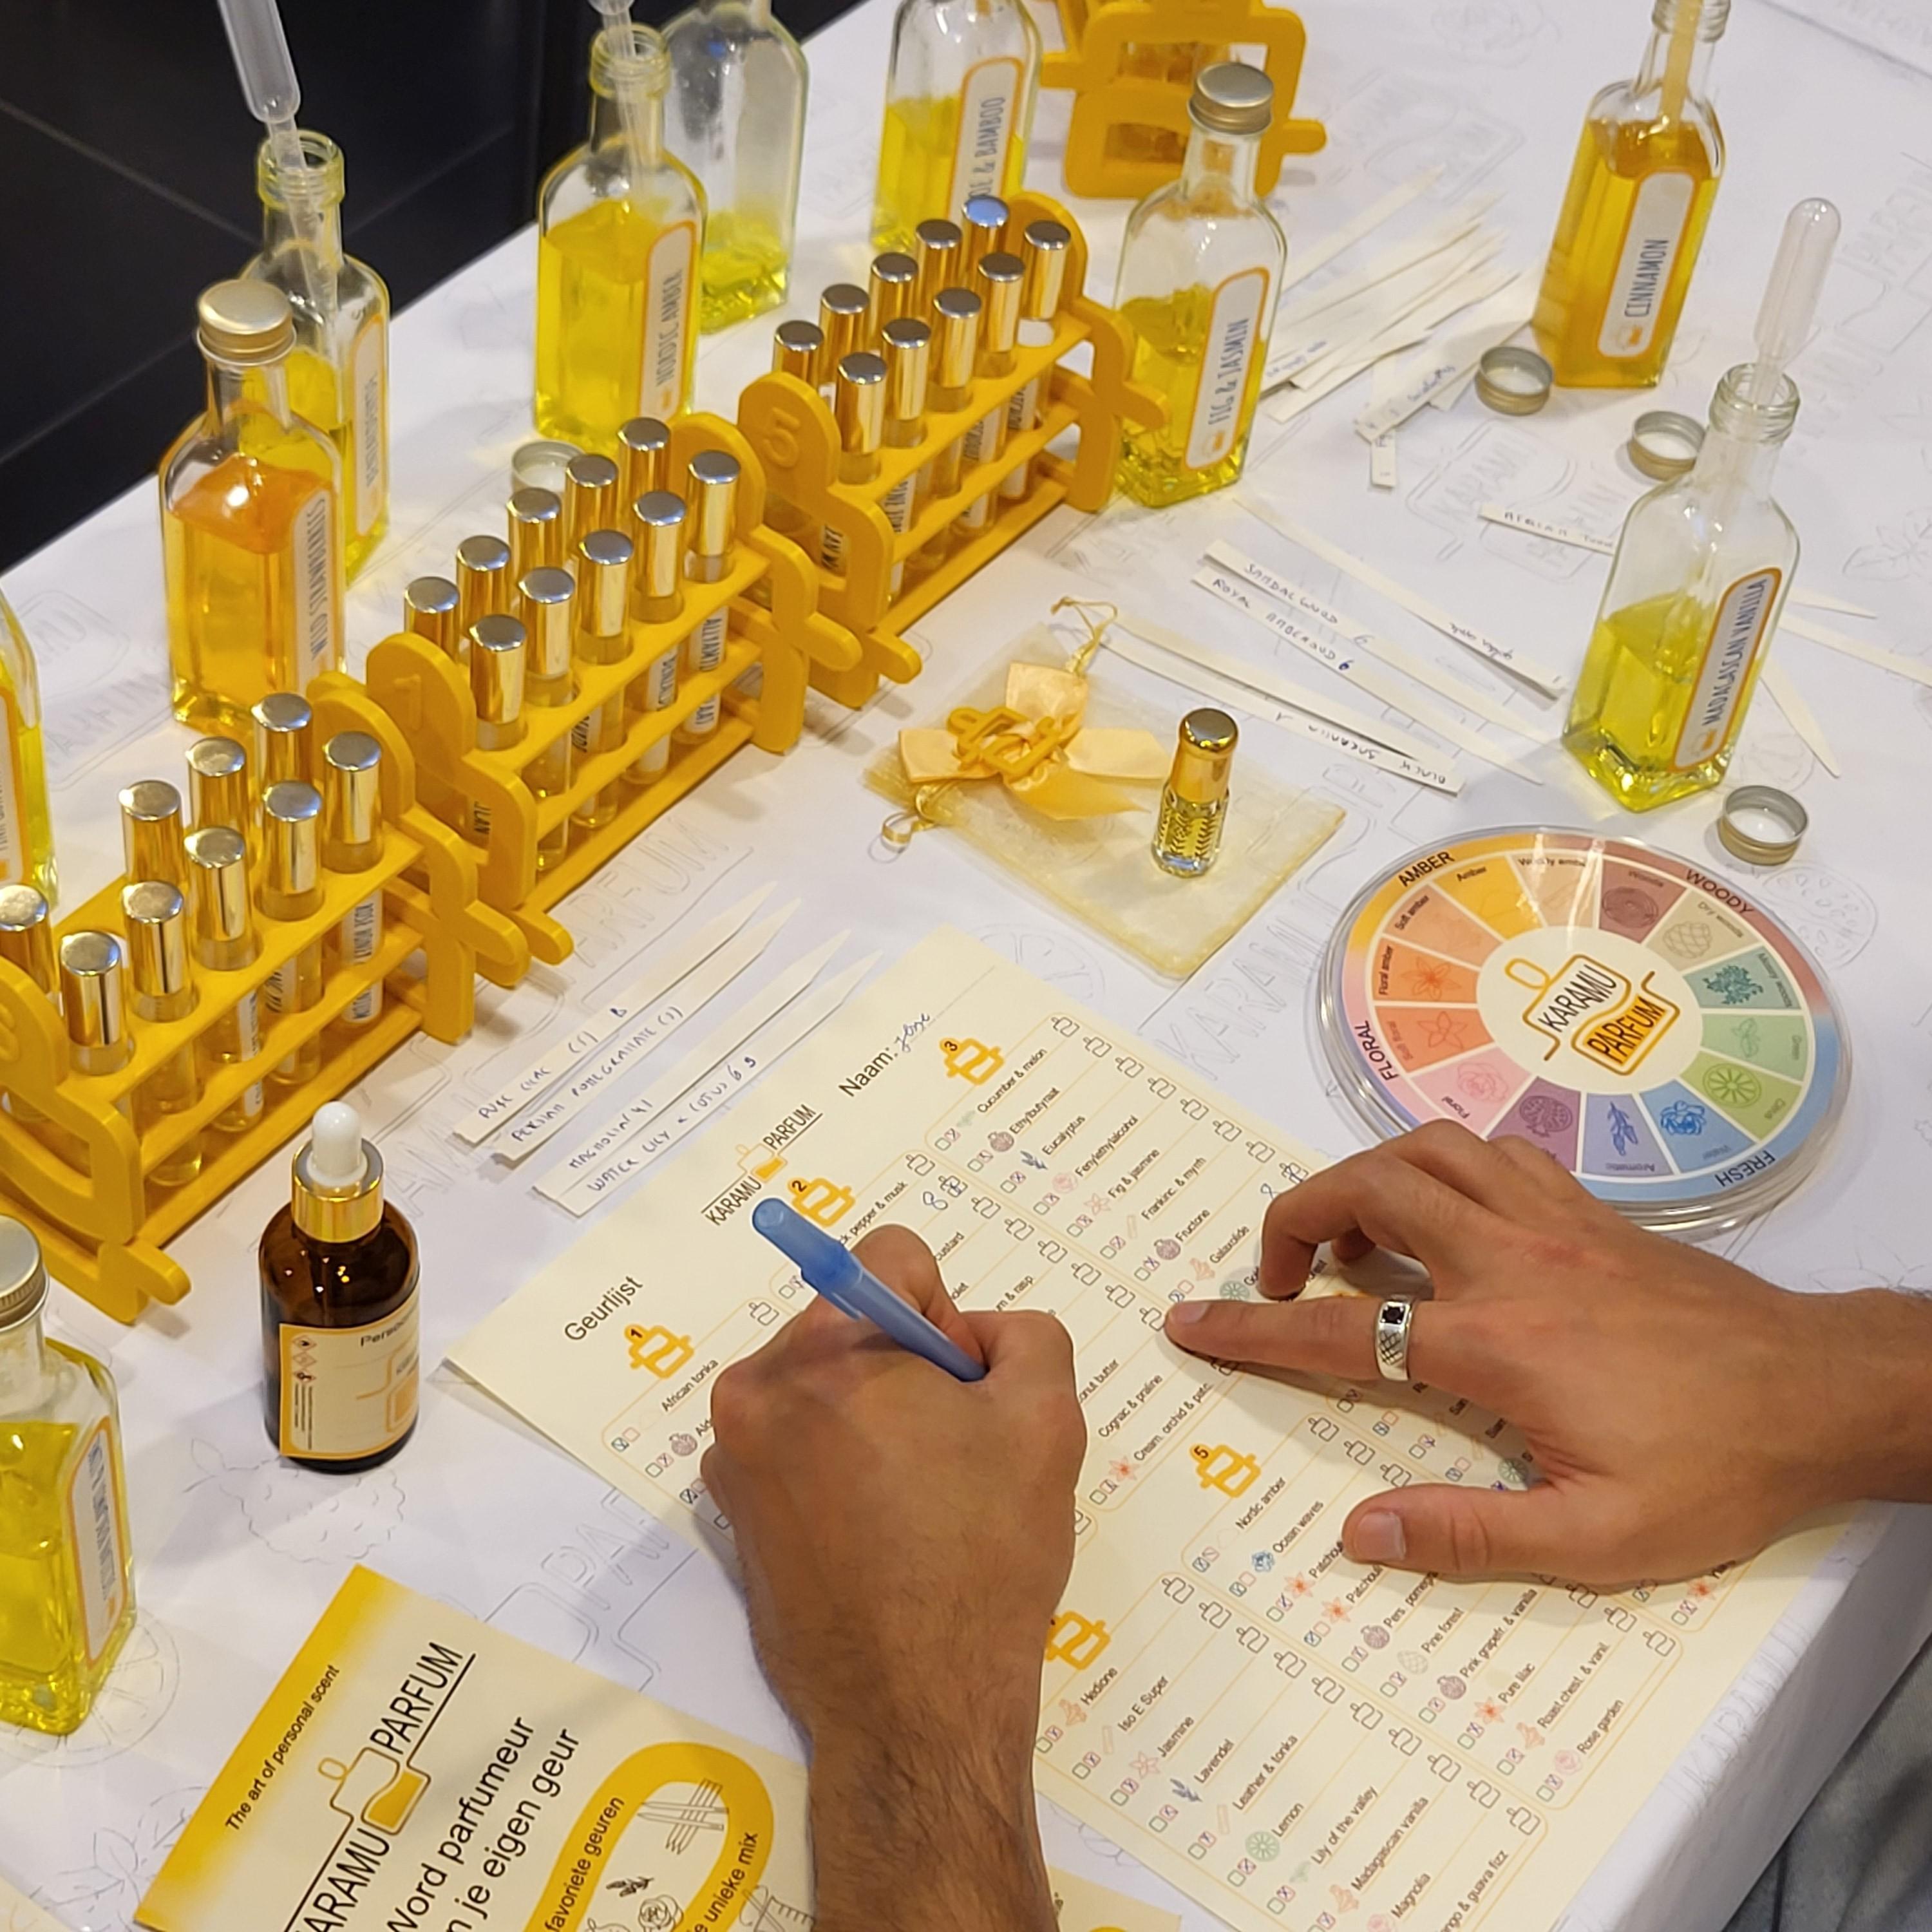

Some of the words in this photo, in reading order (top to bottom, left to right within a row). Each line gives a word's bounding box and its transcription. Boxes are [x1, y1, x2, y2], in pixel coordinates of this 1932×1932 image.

[974, 97, 1005, 158] BAMBOO
[1624, 240, 1669, 317] CINNAMON
[1218, 319, 1249, 379] JASMIN
[1208, 395, 1235, 425] FIG
[1398, 851, 1455, 887] AMBER
[1456, 867, 1487, 882] Amber
[1686, 869, 1755, 914] WOODY
[1537, 963, 1616, 1033] KARAMU
[945, 1041, 958, 1052] 3
[1354, 1020, 1400, 1081] FLORAL
[1587, 996, 1667, 1065] PARFUM
[838, 1046, 899, 1097] Naam:
[977, 1075, 1016, 1113] Cucumber
[1023, 1048, 1047, 1072] melon
[1041, 1115, 1085, 1155] Eucalyptus
[705, 1175, 762, 1226] KARAMU
[762, 1104, 817, 1150] PARFUM
[792, 1180, 808, 1192] 2
[1108, 1183, 1126, 1198] Fig
[1130, 1149, 1160, 1180] jasmine
[1714, 1149, 1776, 1189] FRESH
[850, 1209, 877, 1238] pepper
[884, 1181, 909, 1204] musk
[1175, 1209, 1210, 1242] Fructone
[564, 1275, 643, 1341] Geurlijst
[631, 1329, 643, 1339] 1
[661, 1381, 694, 1412] African
[690, 1358, 719, 1387] tonka
[1094, 1358, 1119, 1383] butter
[1097, 1408, 1131, 1438] Cognac
[1135, 1374, 1163, 1403] praline
[1162, 1408, 1188, 1434] orchid
[1194, 1445, 1209, 1459] 5
[1235, 1503, 1264, 1530] Nordic
[1260, 1477, 1286, 1505] amber
[1273, 1526, 1300, 1553] Ocean
[1297, 1501, 1324, 1529] waves
[1421, 1632, 1444, 1654] Pine
[1438, 1607, 1464, 1633] forest
[1459, 1658, 1482, 1678] Pink
[1511, 1588, 1537, 1618] vanilla
[1081, 1667, 1117, 1705] Hedione
[1117, 1714, 1137, 1732] Iso
[1132, 1703, 1144, 1716] E
[1140, 1676, 1169, 1706] Super
[1498, 1682, 1520, 1703] Pure
[1515, 1663, 1535, 1682] lilac
[225, 1801, 252, 1832] The
[249, 1778, 267, 1802] art
[261, 1759, 278, 1779] of
[272, 1702, 315, 1766] personal
[310, 1663, 341, 1703] scent
[1157, 1716, 1194, 1758] Jasmine
[1577, 1730, 1601, 1754] Rose
[1598, 1700, 1624, 1732] garden
[299, 1828, 390, 1932] ARAMU
[369, 1642, 464, 1756] PARFUM
[1194, 1738, 1234, 1784] Lavendel
[1233, 1772, 1266, 1811] Leather
[1271, 1735, 1298, 1764] tonka
[386, 1863, 448, 1932] Word
[437, 1716, 535, 1865] parfumeur
[454, 1883, 491, 1920] je
[483, 1799, 541, 1879] eigen
[532, 1728, 580, 1798] geur
[1271, 1803, 1304, 1837] Lemon
[1311, 1845, 1332, 1864] Lily
[1328, 1830, 1340, 1846] of
[1336, 1815, 1353, 1834] the
[1352, 1786, 1379, 1816] valley
[1351, 1828, 1404, 1891] Madagascan
[1400, 1797, 1429, 1830] vanilla
[545, 1858, 591, 1932] favoriete
[583, 1797, 625, 1857] geuren
[704, 1868, 745, 1923] unieke
[738, 1832, 759, 1866] mix
[1467, 1870, 1493, 1903] guava
[1488, 1850, 1508, 1870] fizz
[1390, 1873, 1431, 1918] Magnolia
